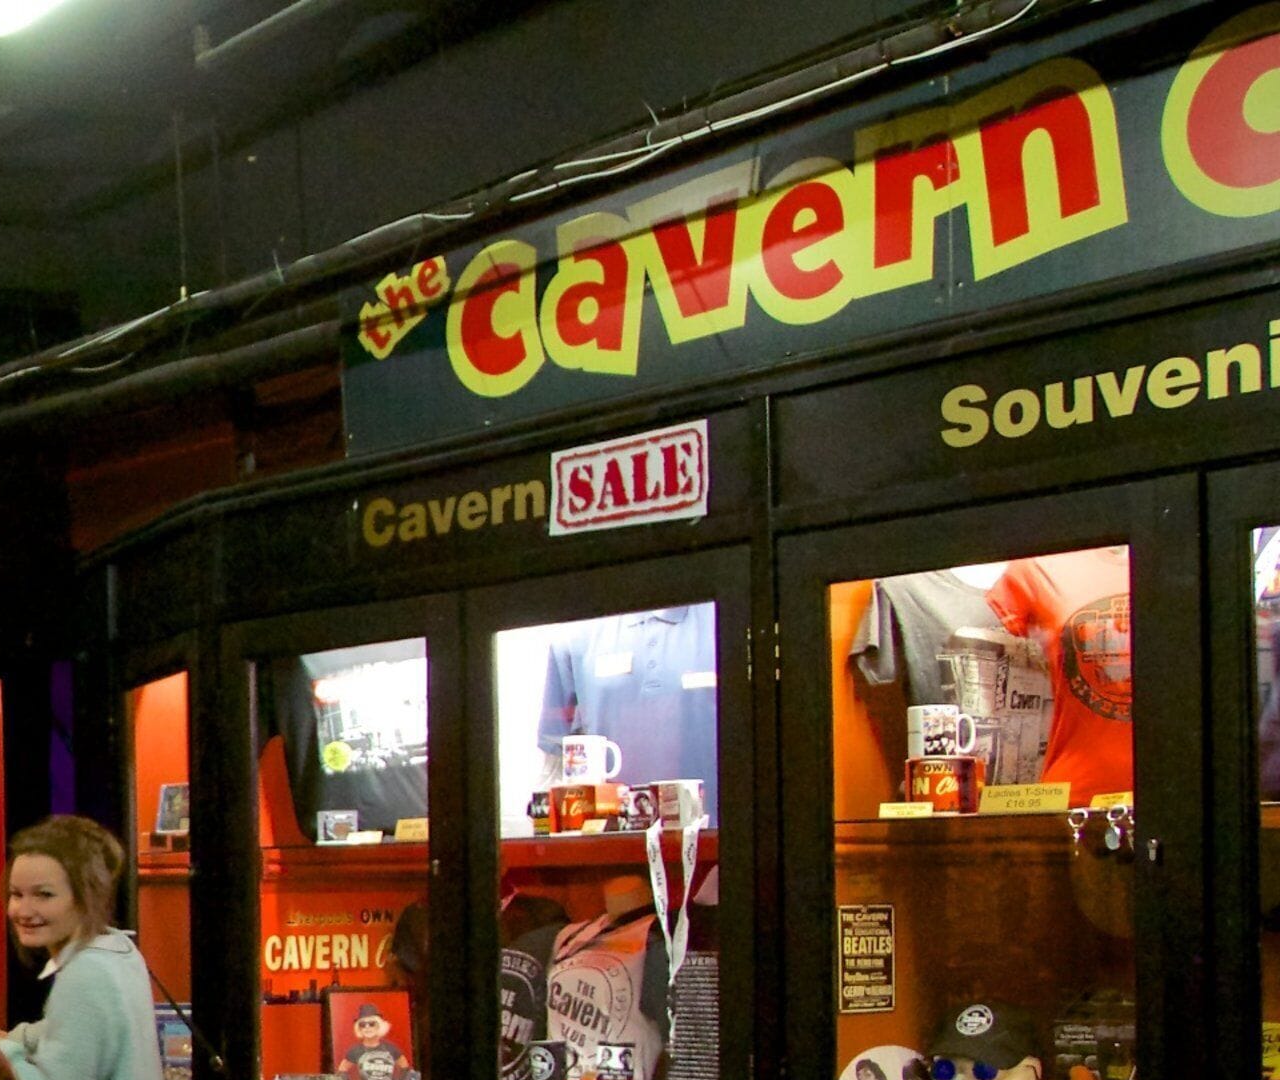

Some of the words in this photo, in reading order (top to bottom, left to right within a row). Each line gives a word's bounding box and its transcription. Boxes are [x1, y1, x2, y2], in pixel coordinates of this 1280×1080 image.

[568, 442, 693, 514] SALE
[362, 478, 545, 547] Cavern
[264, 934, 370, 972] CAVERN
[843, 936, 893, 955] BEATLES
